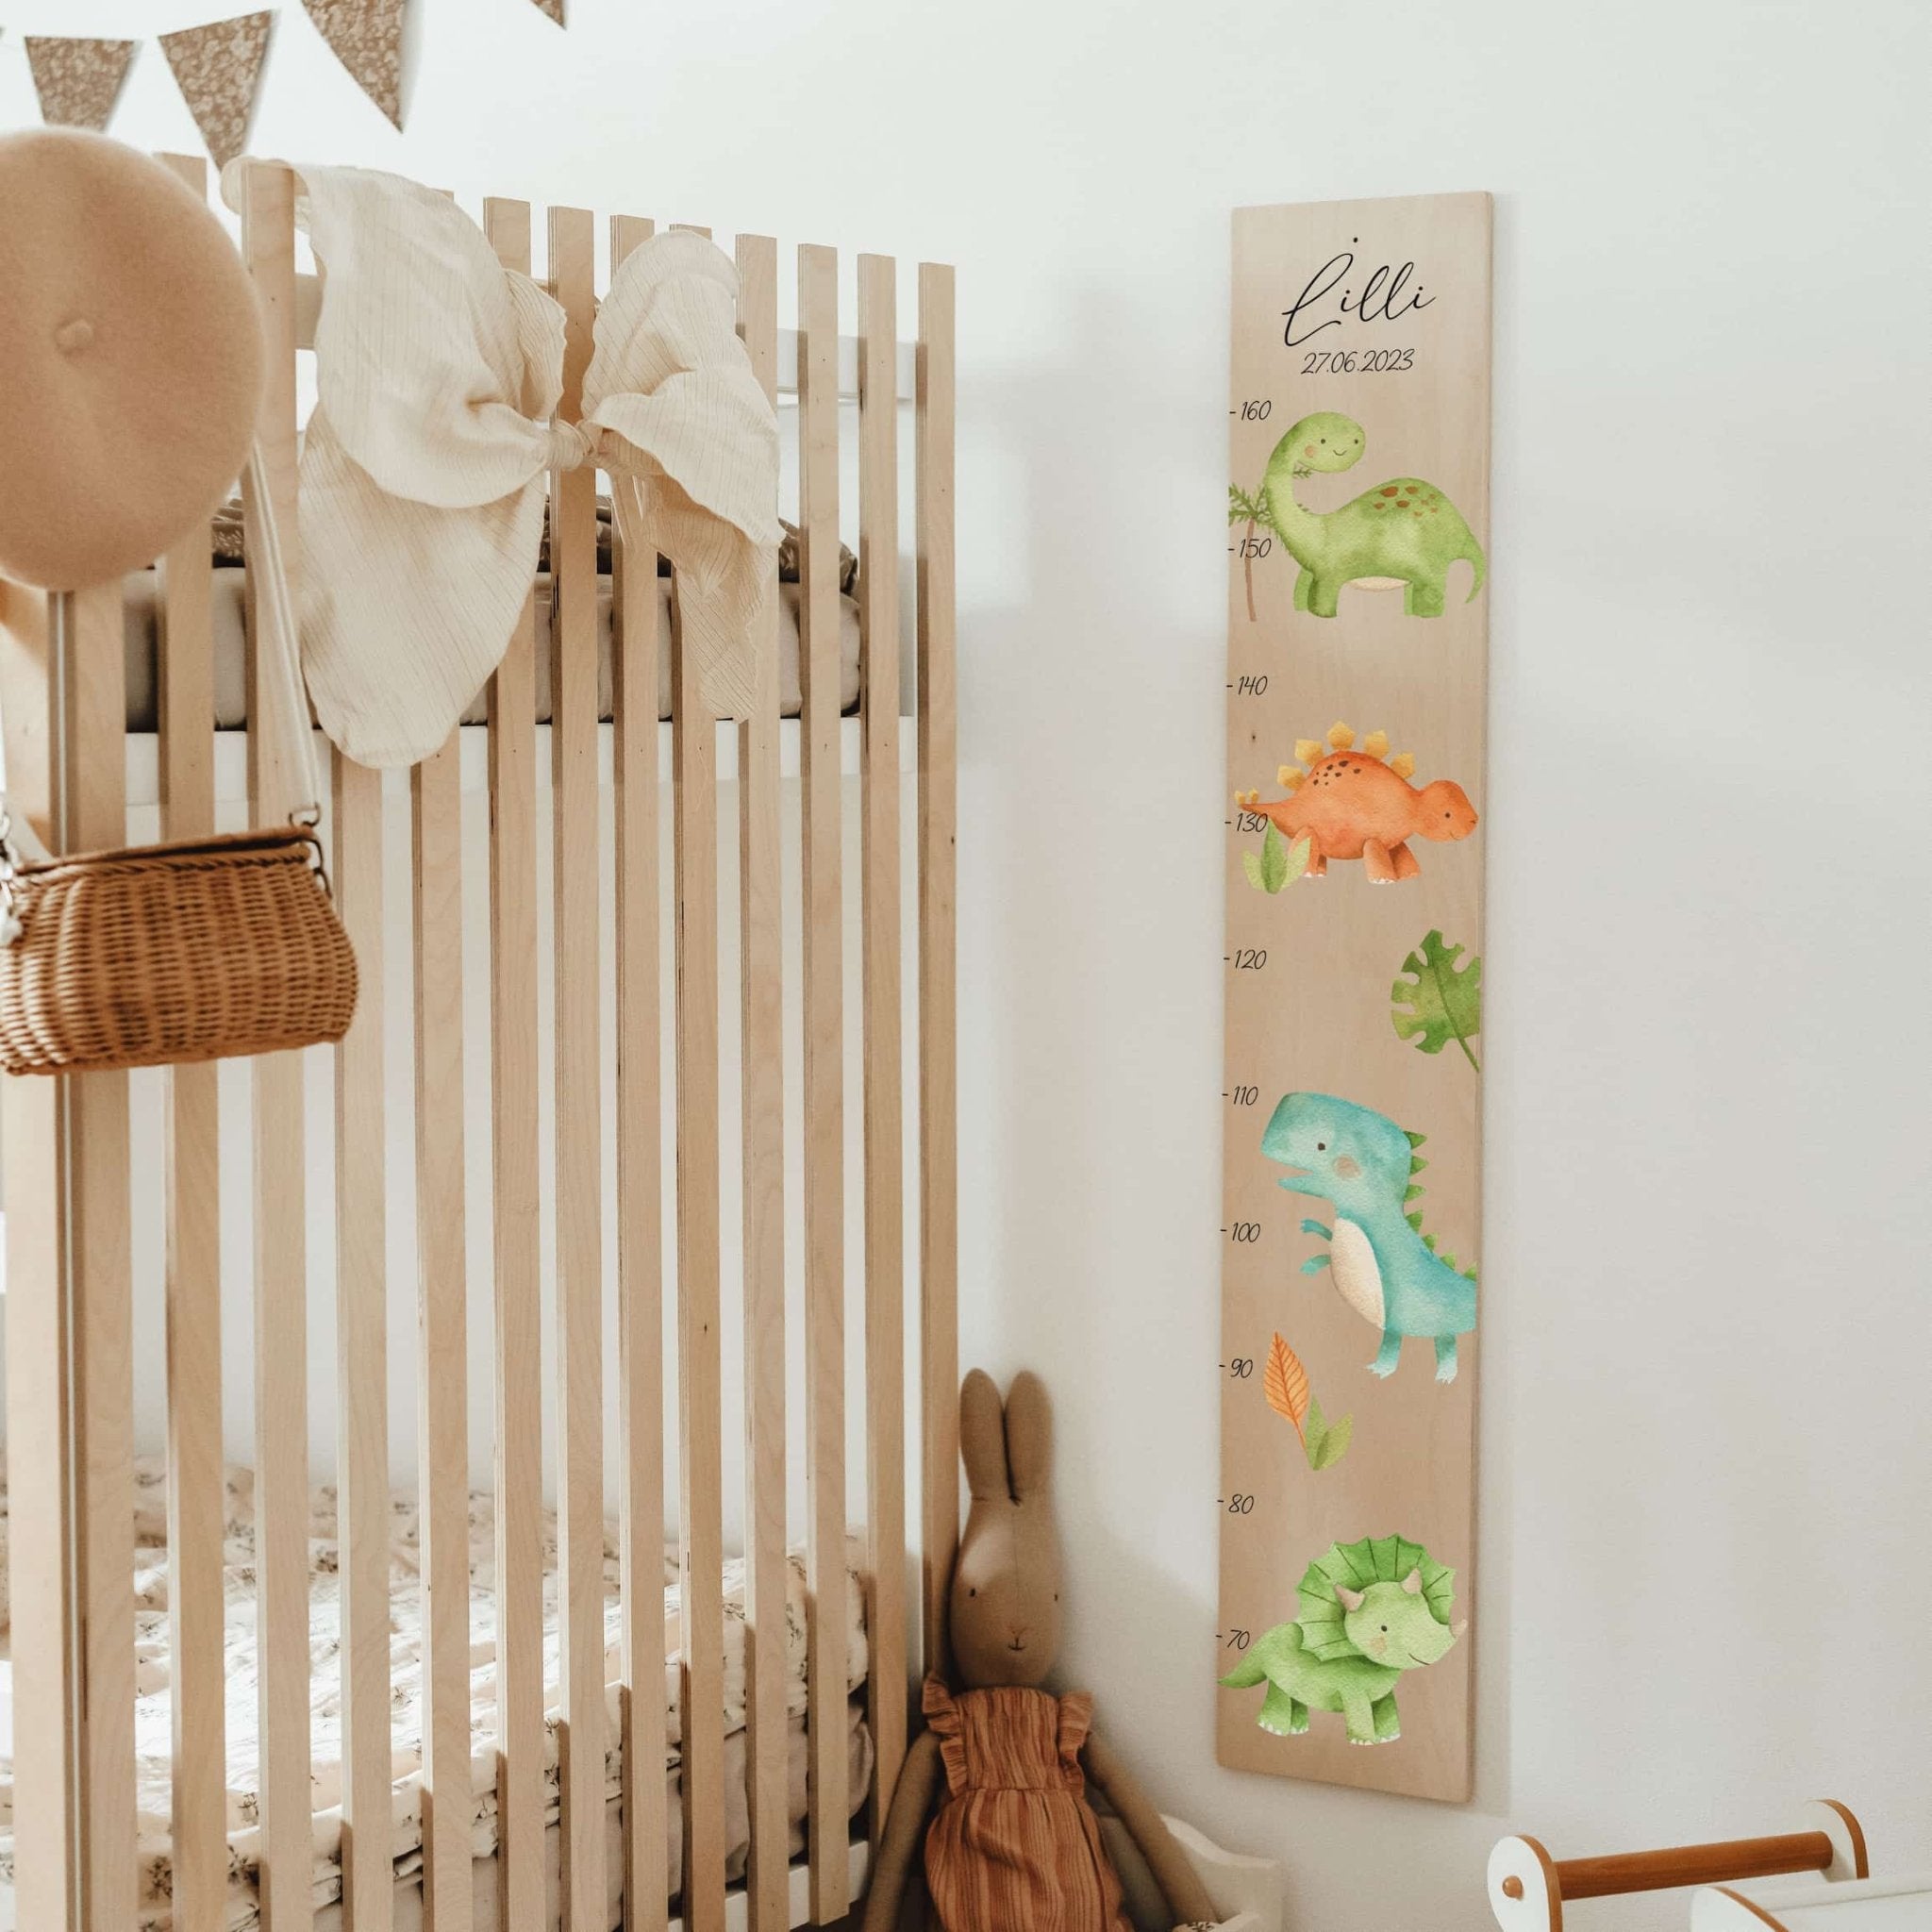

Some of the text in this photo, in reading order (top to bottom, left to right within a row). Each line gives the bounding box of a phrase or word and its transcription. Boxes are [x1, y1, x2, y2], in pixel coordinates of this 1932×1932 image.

[1281, 237, 1437, 346] Lilli
[1300, 348, 1415, 375] 27.06.2023
[1241, 400, 1272, 421] 160
[1240, 538, 1272, 558] 150
[1238, 675, 1269, 696] 140
[1236, 812, 1269, 833] 130
[1235, 949, 1267, 970] 120
[1233, 1086, 1258, 1106] 110
[1231, 1222, 1261, 1243] 100
[1230, 1357, 1254, 1378] 90
[1228, 1493, 1255, 1514] 80
[1226, 1629, 1250, 1650] 70
